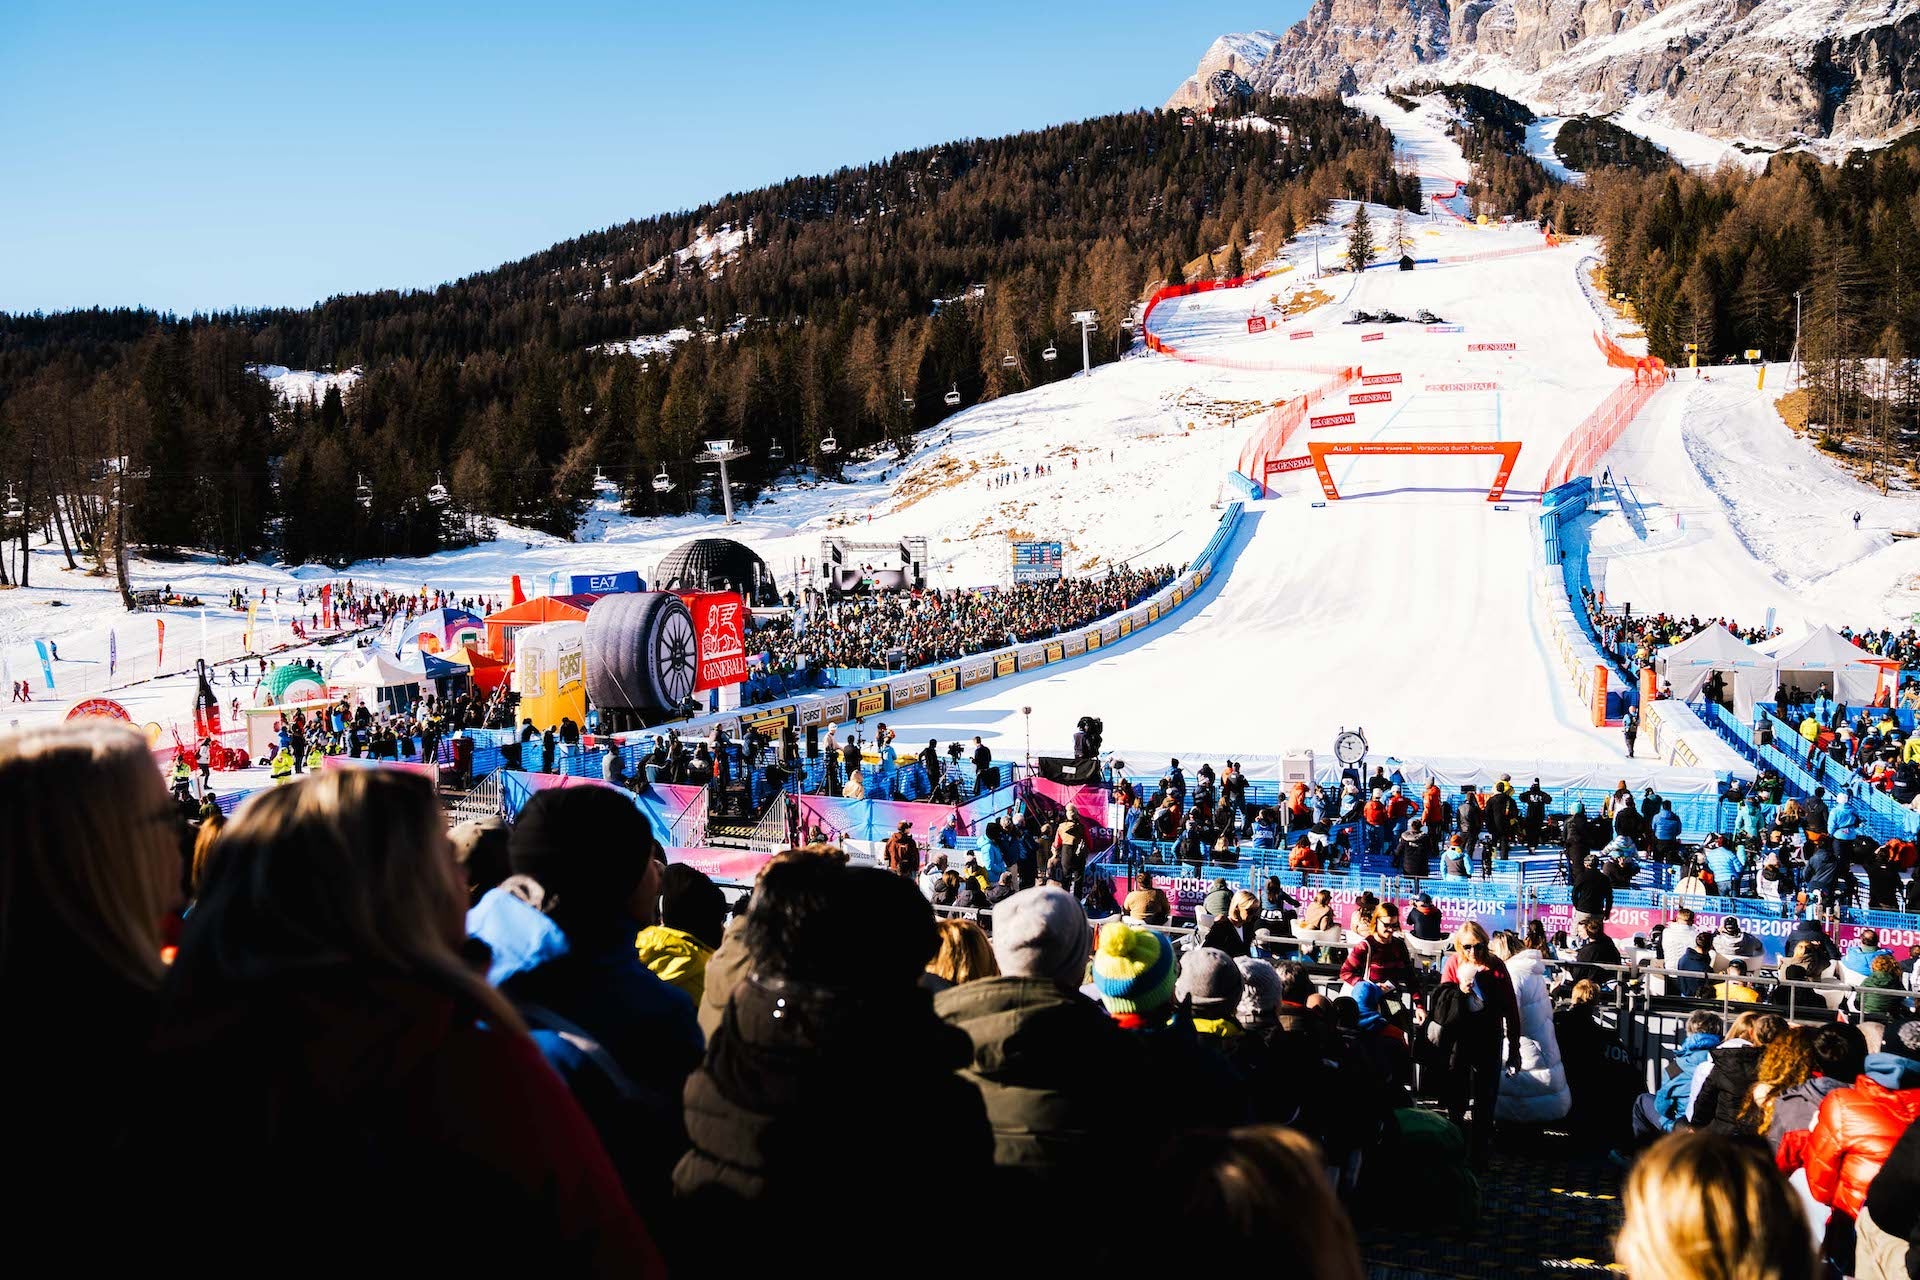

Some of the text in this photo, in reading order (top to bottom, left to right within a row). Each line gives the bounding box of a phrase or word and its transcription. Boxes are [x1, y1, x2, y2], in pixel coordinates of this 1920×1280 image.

[1359, 392, 1391, 402] GENERALI
[1321, 415, 1354, 425] GENERALI
[590, 576, 617, 589] EA7
[1016, 572, 1060, 580] LONGINES
[560, 652, 582, 678] FORST
[703, 657, 744, 681] GENERALI
[965, 670, 976, 680] FORST
[896, 688, 909, 699] FORST
[913, 684, 926, 693] FORST
[938, 678, 955, 692] PIRELLI
[803, 709, 820, 721] FORST
[826, 703, 843, 717] FORST
[860, 697, 882, 713] PIRELLI
